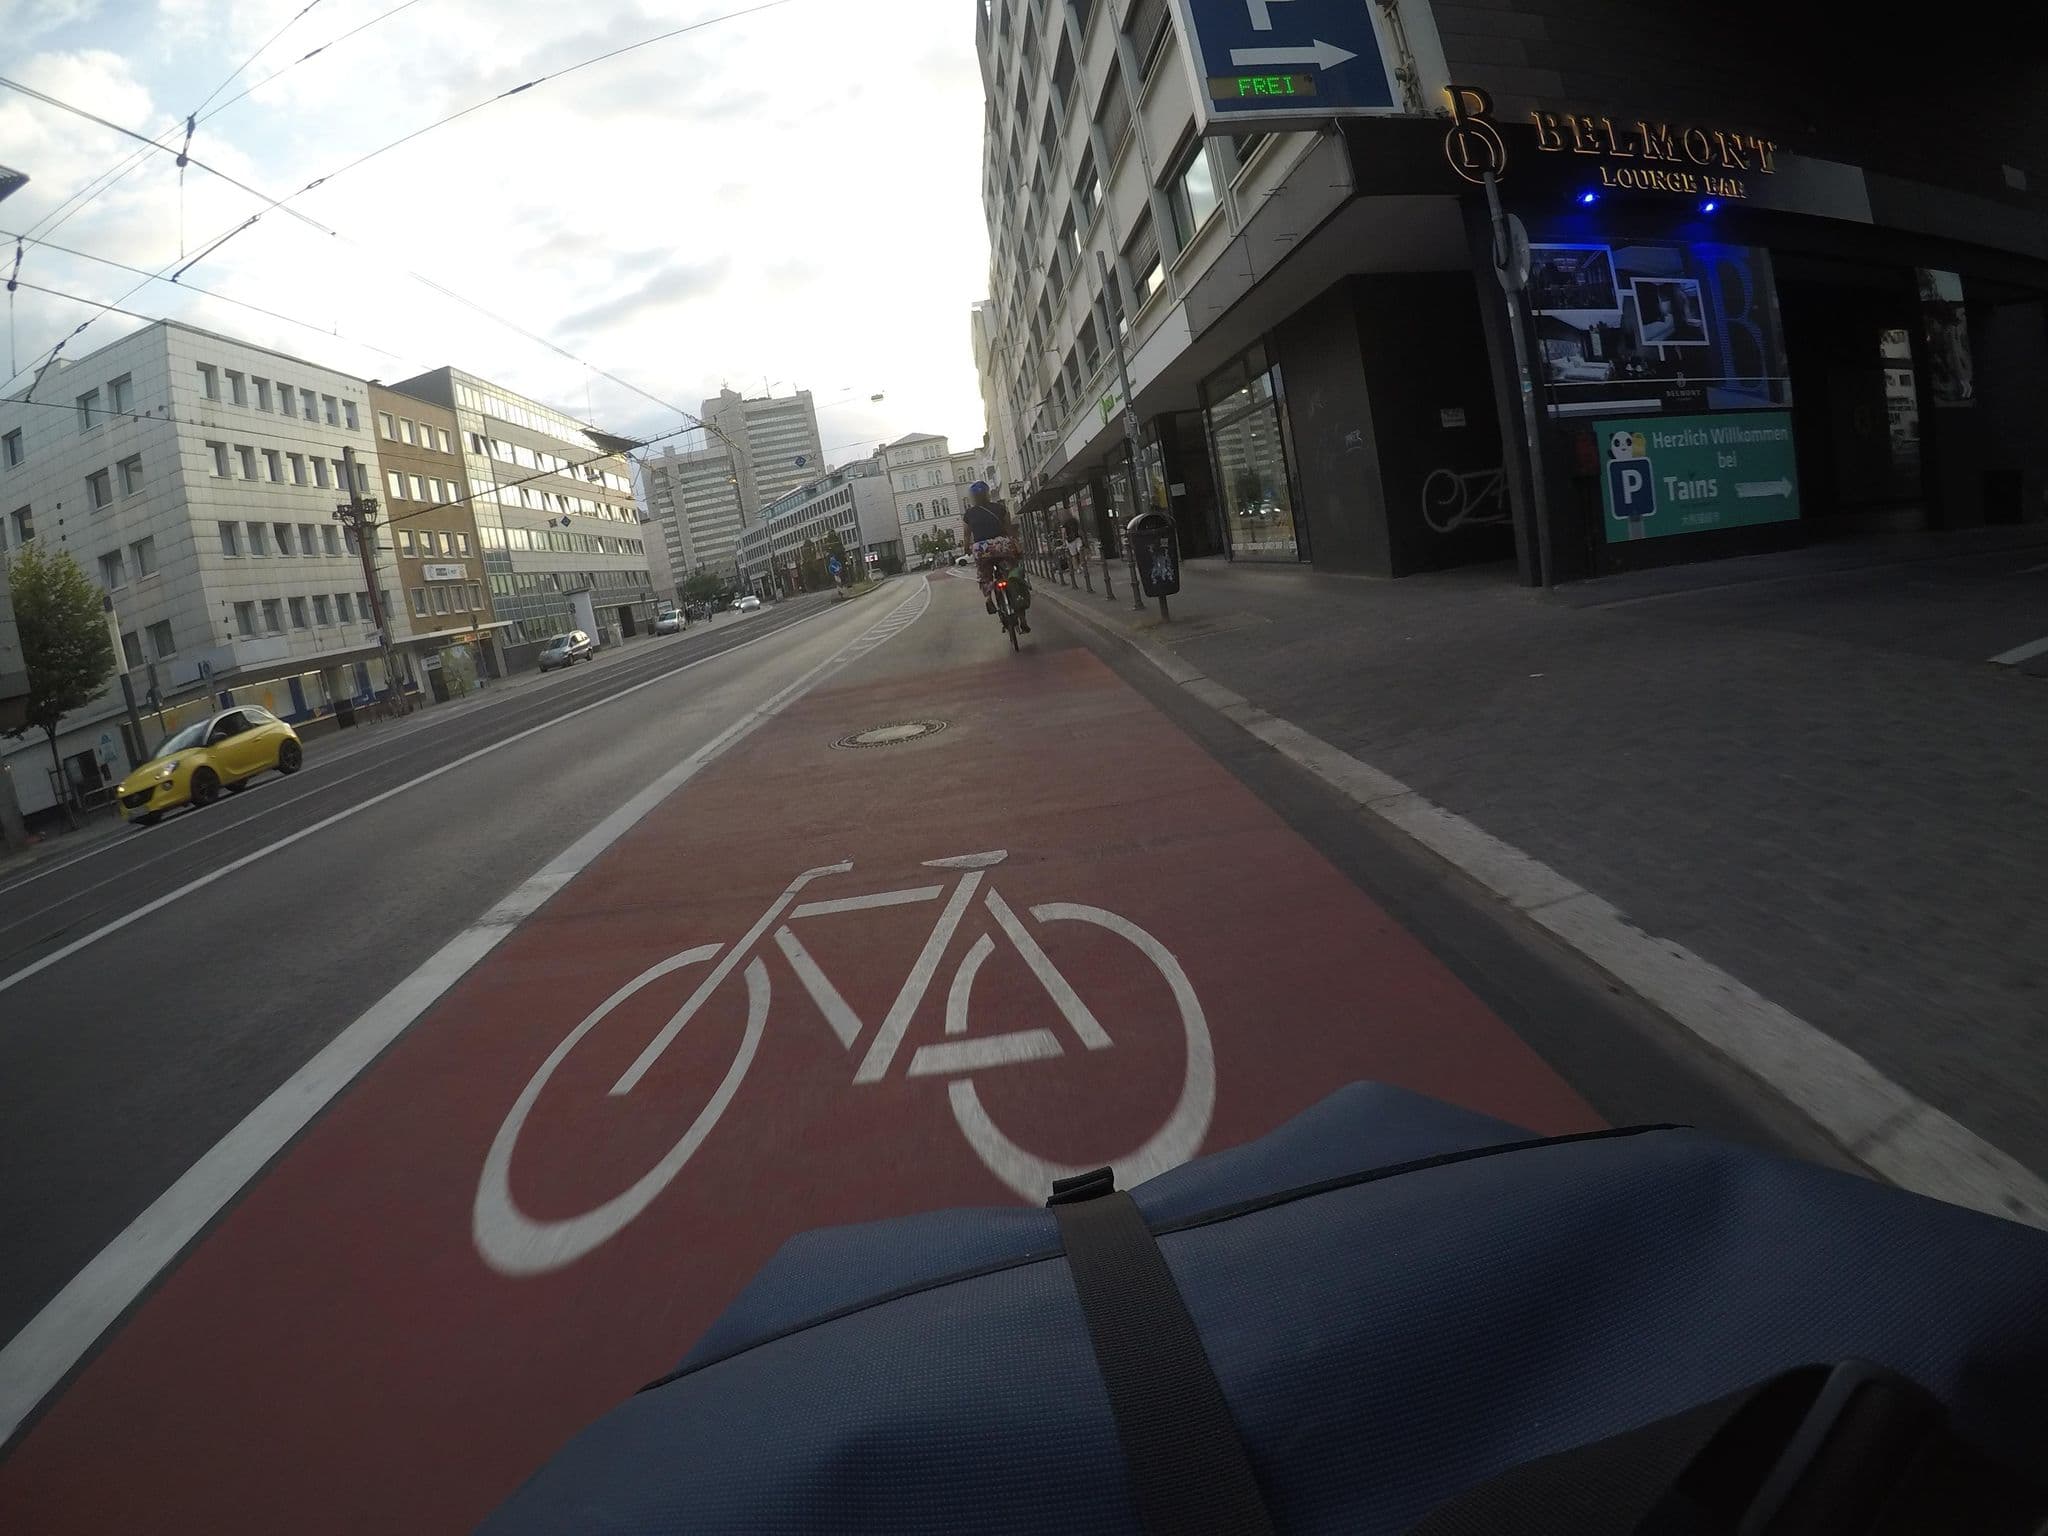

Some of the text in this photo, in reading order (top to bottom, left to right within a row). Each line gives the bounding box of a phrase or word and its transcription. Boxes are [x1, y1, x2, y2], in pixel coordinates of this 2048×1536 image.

[1237, 76, 1295, 97] FREI
[1531, 111, 1778, 175] BELMONT
[1599, 165, 1748, 199] LOUNGE BAR
[1651, 426, 1789, 449] Herzlich Willkommen
[1717, 450, 1738, 469] bei
[1620, 469, 1643, 505] P
[1663, 476, 1719, 502] Tains
